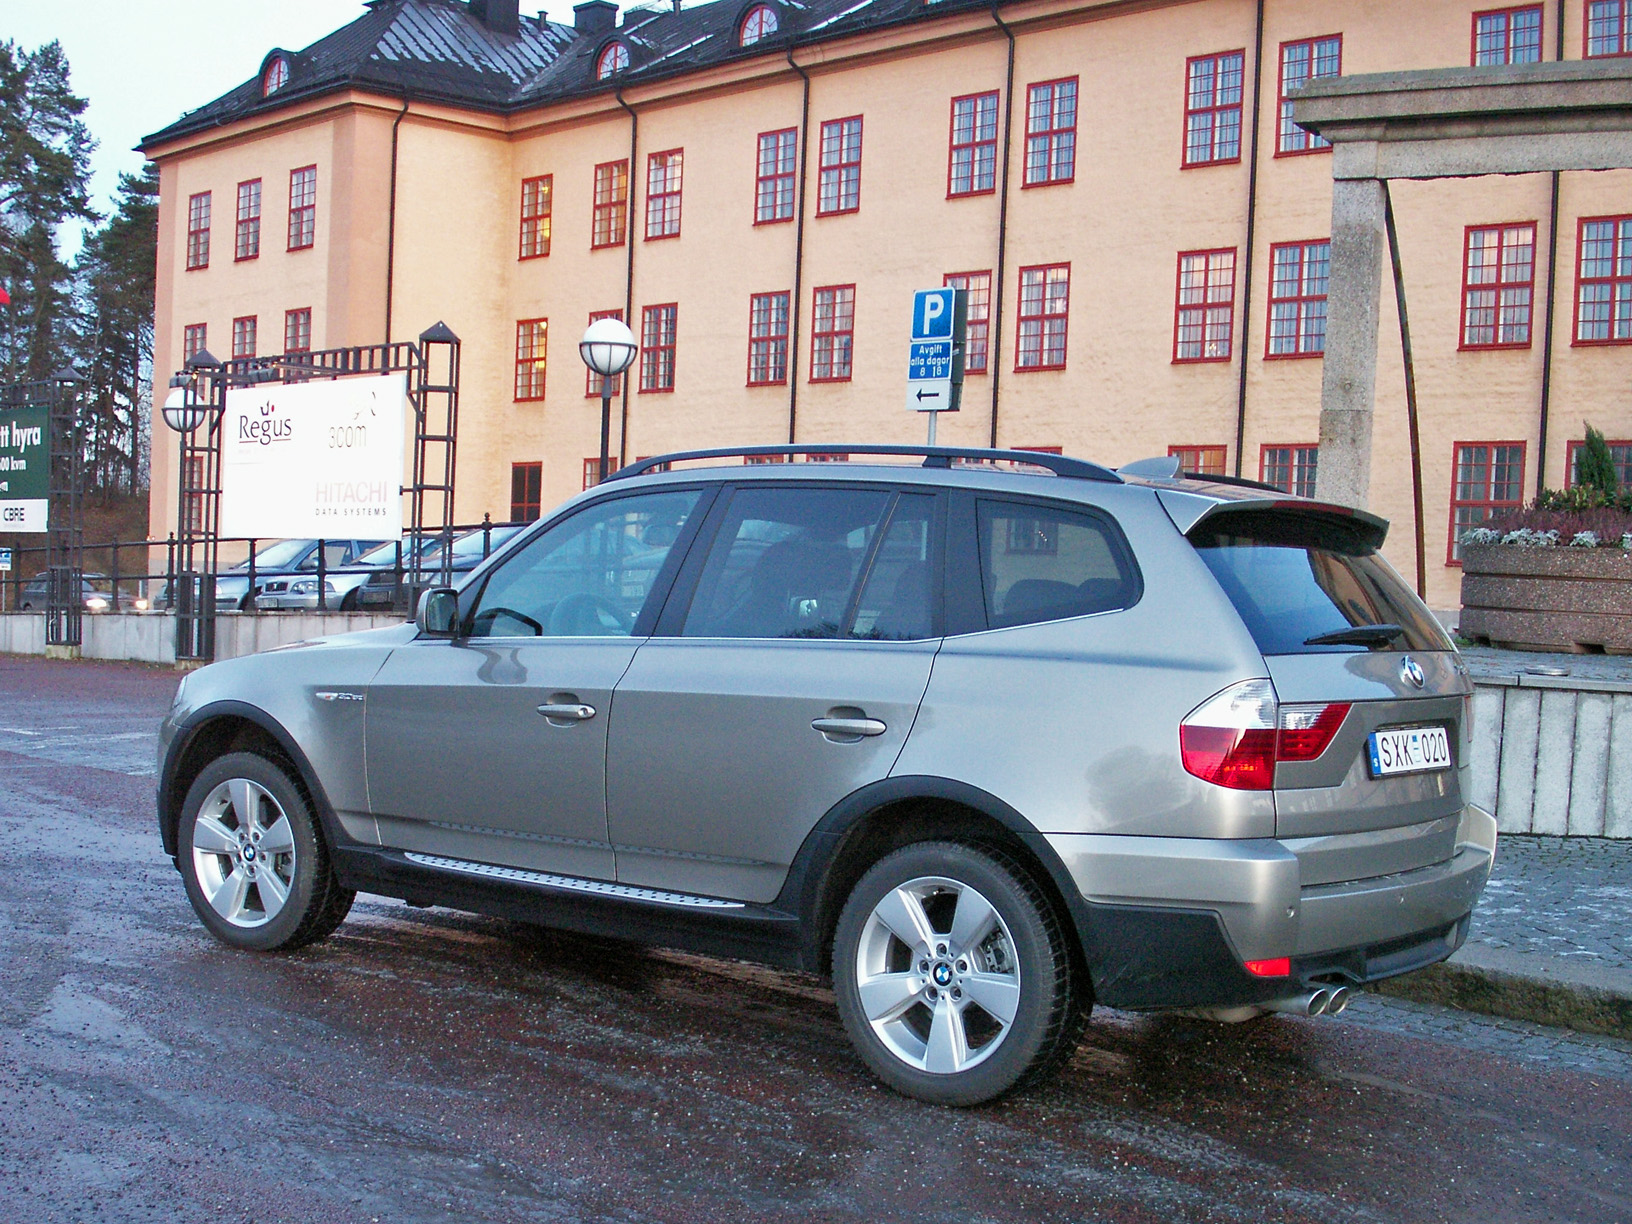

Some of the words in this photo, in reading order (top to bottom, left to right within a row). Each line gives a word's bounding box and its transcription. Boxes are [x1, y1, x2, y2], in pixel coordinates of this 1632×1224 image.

[923, 294, 944, 335] P
[919, 344, 942, 356] Avgift
[910, 357, 925, 366] alla
[926, 356, 950, 367] dagar
[919, 367, 926, 377] 8
[932, 365, 942, 378] 18
[0, 425, 10, 448] tt
[12, 421, 42, 454] hyra
[239, 415, 292, 446] Regus
[0, 456, 10, 472] 00
[315, 481, 388, 503] HITACHI
[4, 507, 25, 522] CBRE
[315, 508, 338, 517] DATA
[343, 507, 387, 516] SYSTEMS
[1381, 733, 1414, 768] SXK
[1421, 732, 1447, 764] 020
